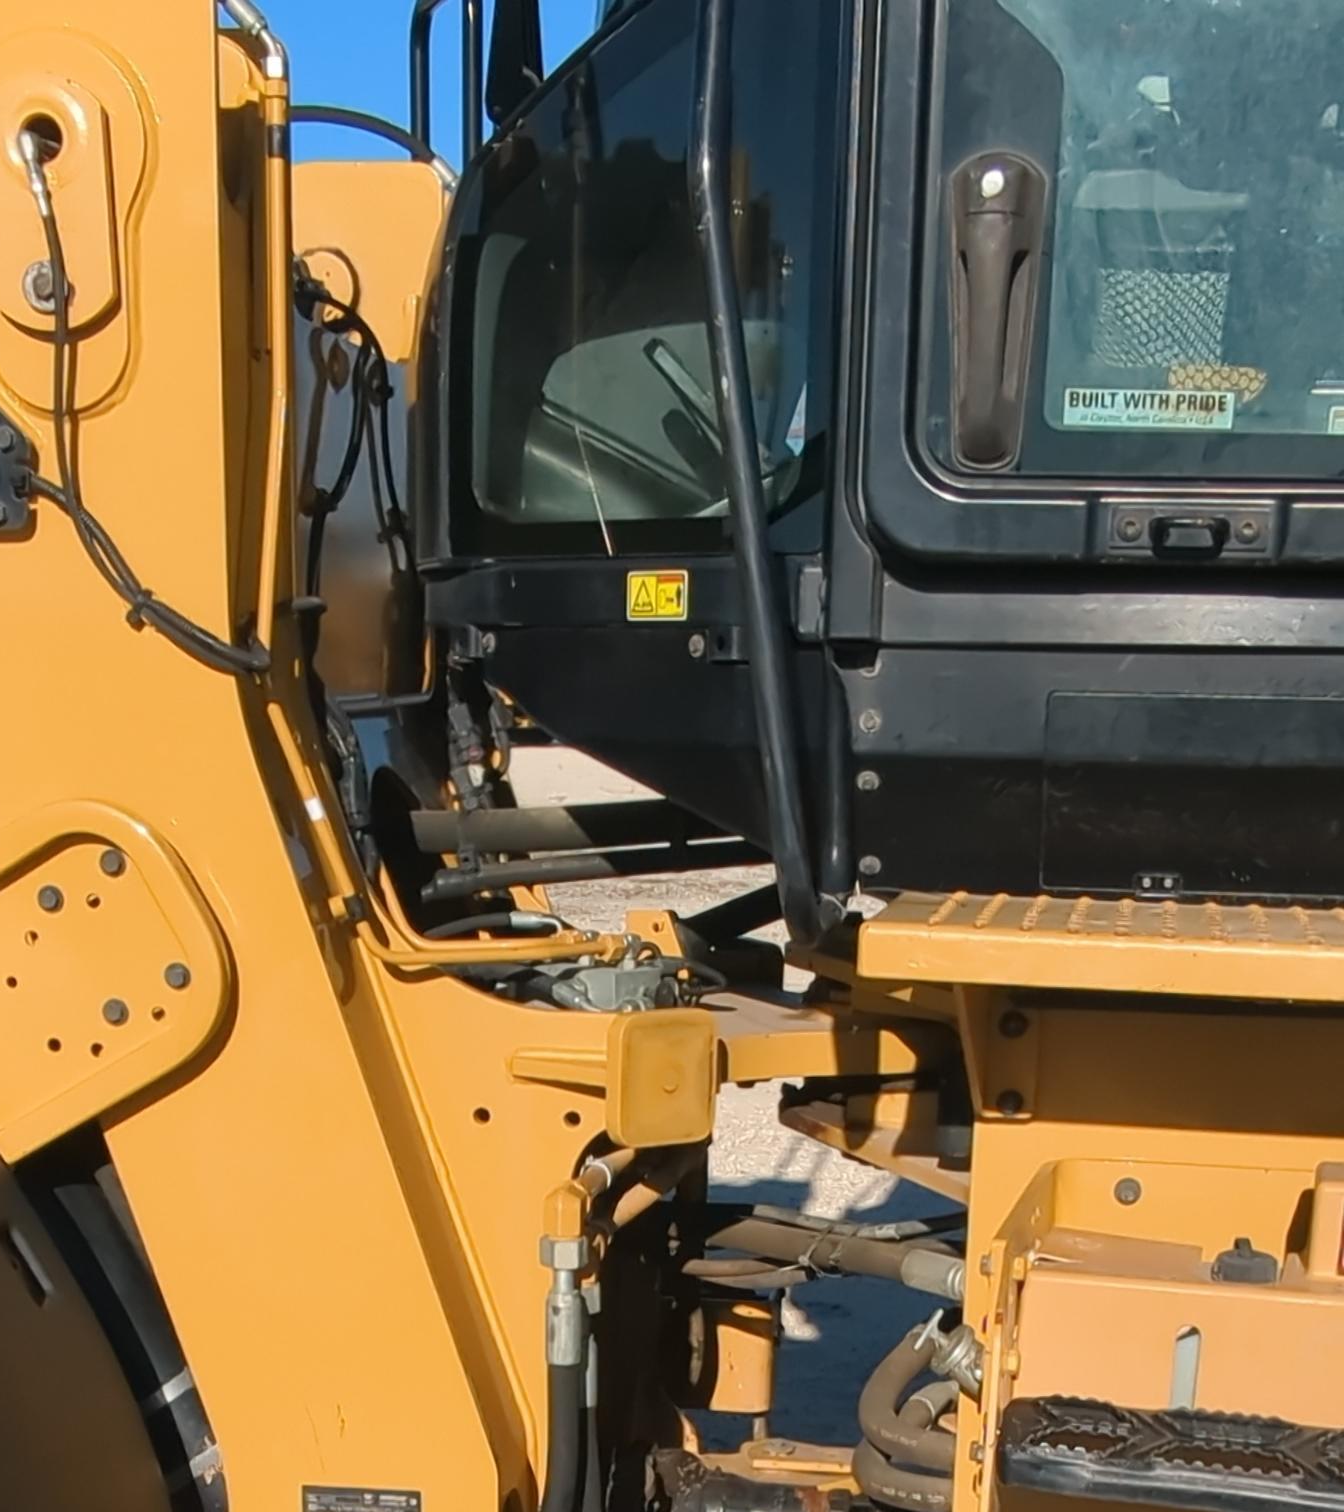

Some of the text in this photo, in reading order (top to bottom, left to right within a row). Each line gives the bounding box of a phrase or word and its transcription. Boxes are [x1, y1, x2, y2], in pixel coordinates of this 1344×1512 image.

[1068, 391, 1227, 414] BUILT WITH PRIDE
